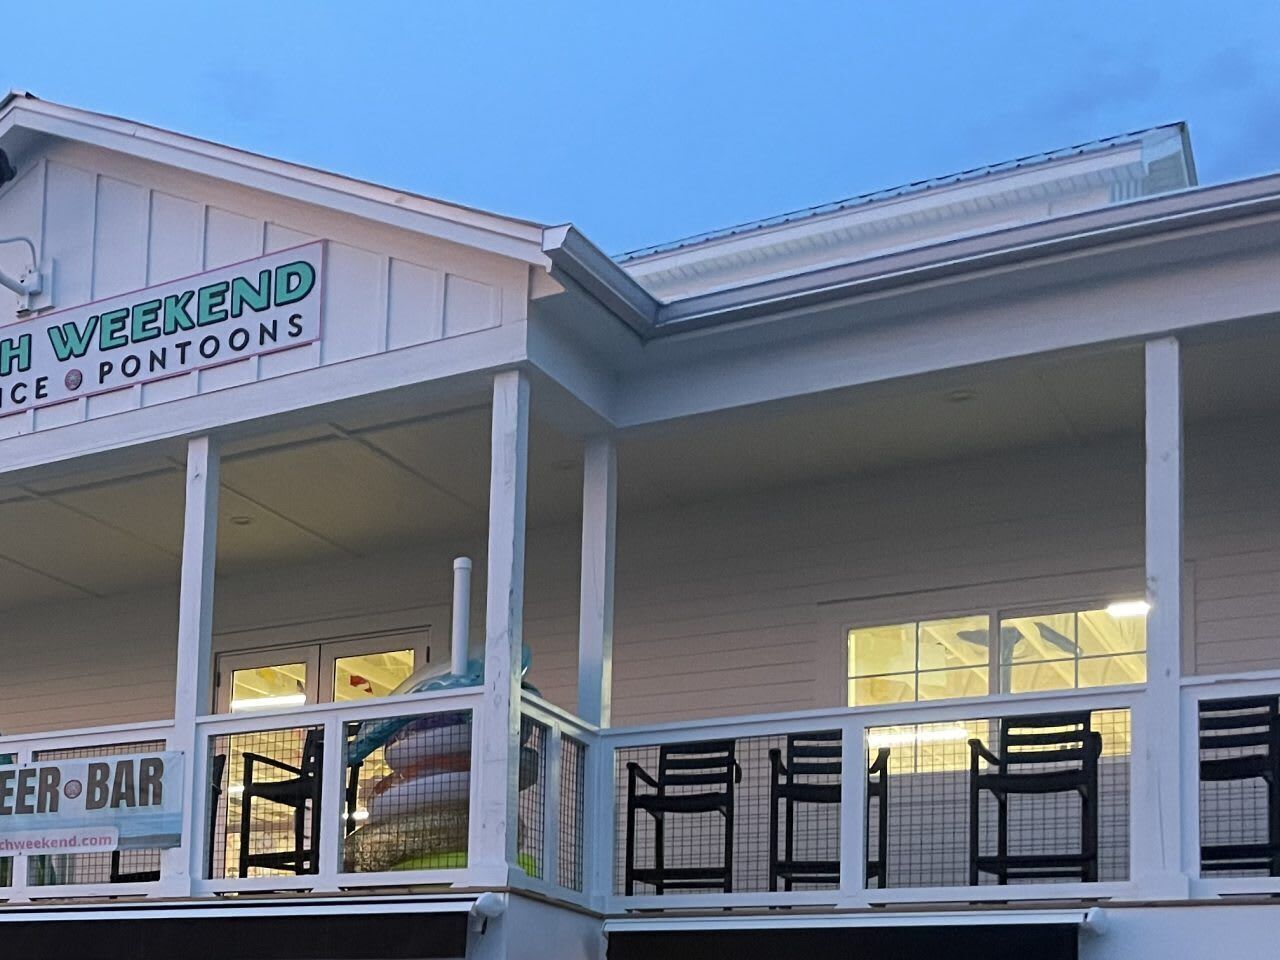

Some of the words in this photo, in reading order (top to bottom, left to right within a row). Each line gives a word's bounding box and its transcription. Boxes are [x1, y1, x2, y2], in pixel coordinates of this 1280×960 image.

[48, 260, 316, 361] WEEKEND
[99, 313, 304, 384] PONTOONS
[85, 757, 164, 810] BAR
